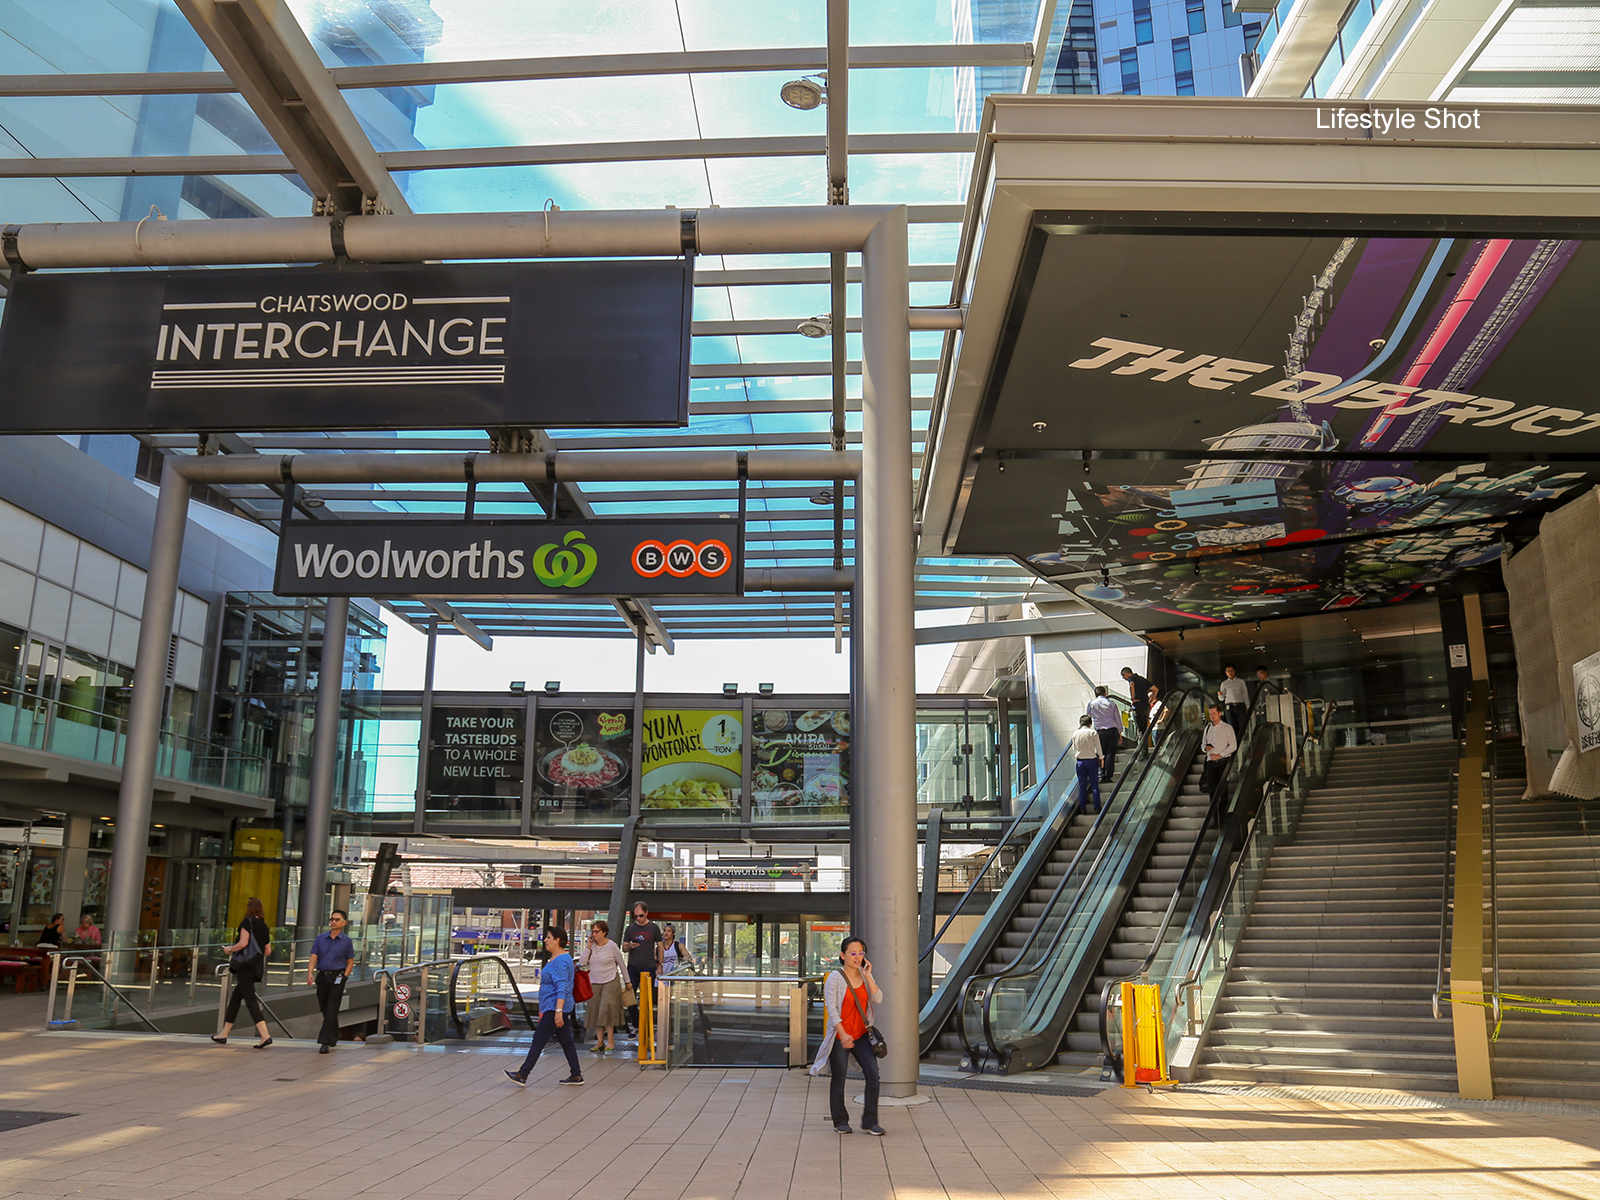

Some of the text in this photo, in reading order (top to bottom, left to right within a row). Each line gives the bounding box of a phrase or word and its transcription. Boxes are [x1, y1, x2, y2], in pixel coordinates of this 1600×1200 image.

[260, 293, 408, 313] CHATSWOOD
[155, 316, 507, 361] INTERCHANGE
[1068, 336, 1274, 391] THE
[294, 539, 525, 579] Woolworths
[446, 717, 514, 729] TAKE YOUR
[445, 733, 517, 745] TASTEBUDS
[784, 733, 826, 744] AKIRA
[444, 748, 517, 761] TO A WHOLE
[714, 745, 732, 754] TON
[759, 740, 832, 767] Discover
[443, 765, 510, 778] NEW LEVEL.
